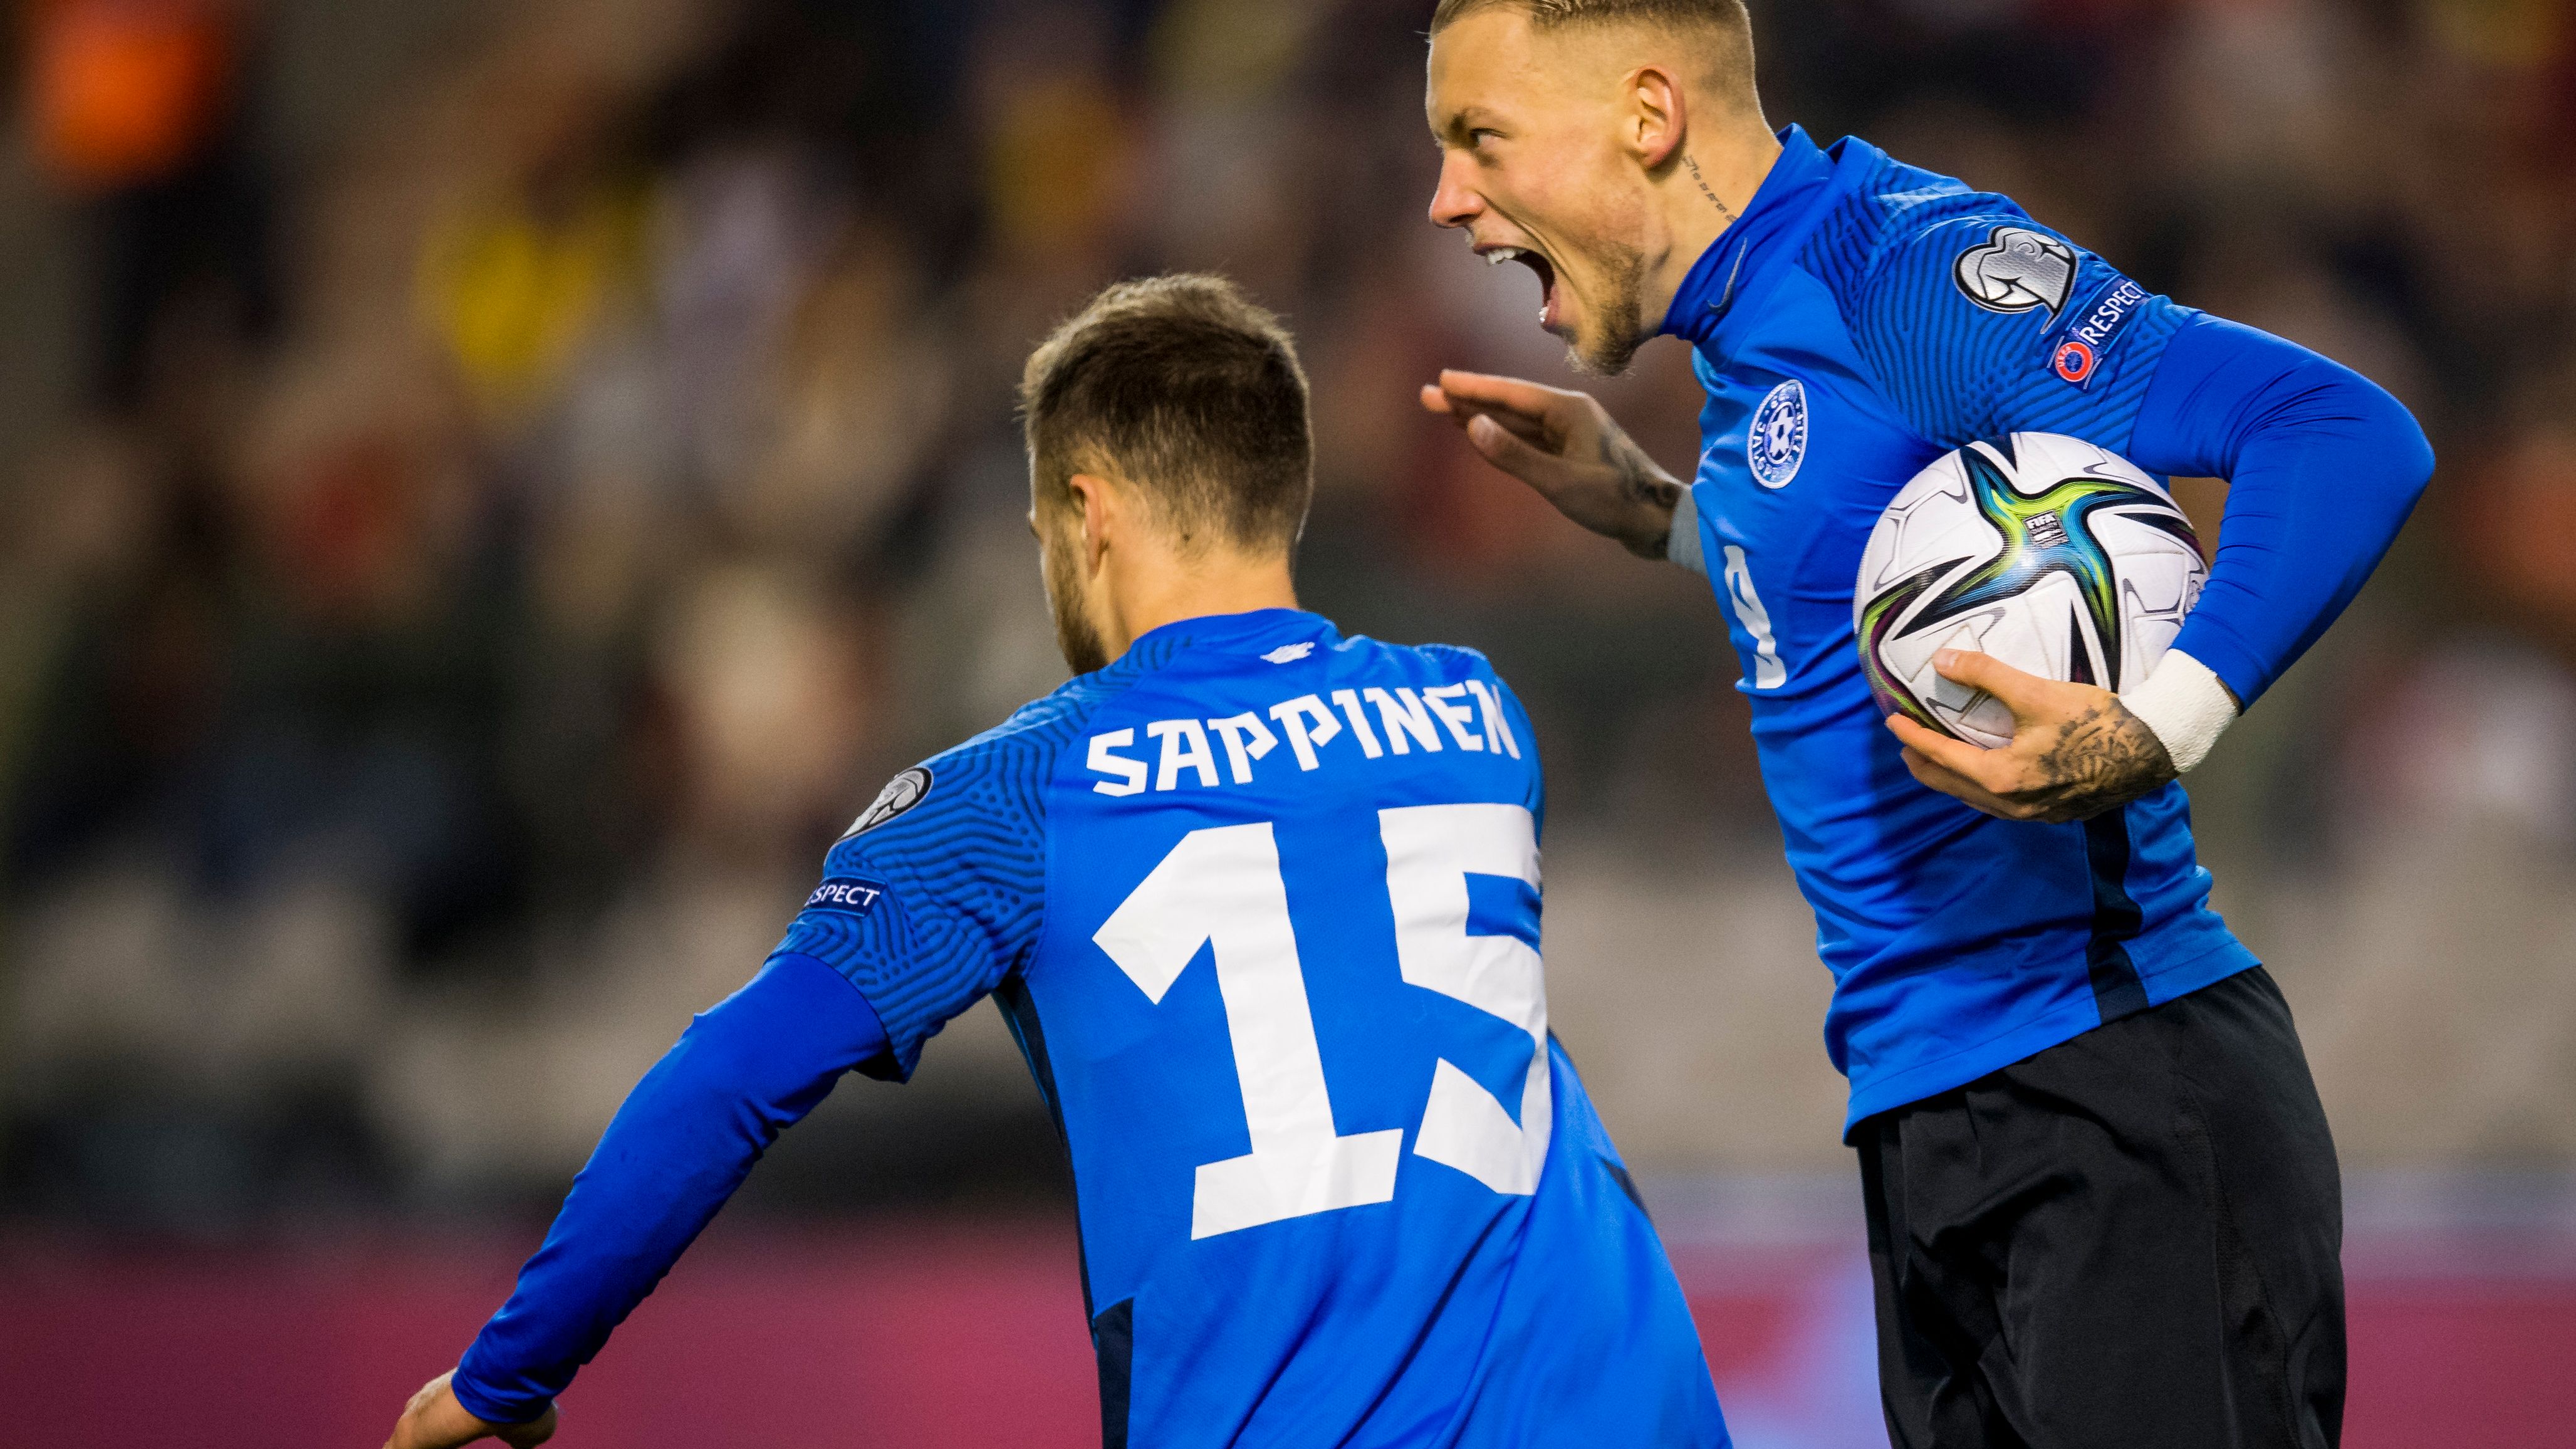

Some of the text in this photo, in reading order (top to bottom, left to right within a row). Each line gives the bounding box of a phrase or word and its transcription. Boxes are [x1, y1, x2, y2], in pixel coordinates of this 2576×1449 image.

[2080, 281, 2146, 345] RESPECT
[2027, 513, 2058, 530] FIFA
[1086, 679, 1521, 797] SAPPINEN
[1092, 802, 1553, 1241] 15
